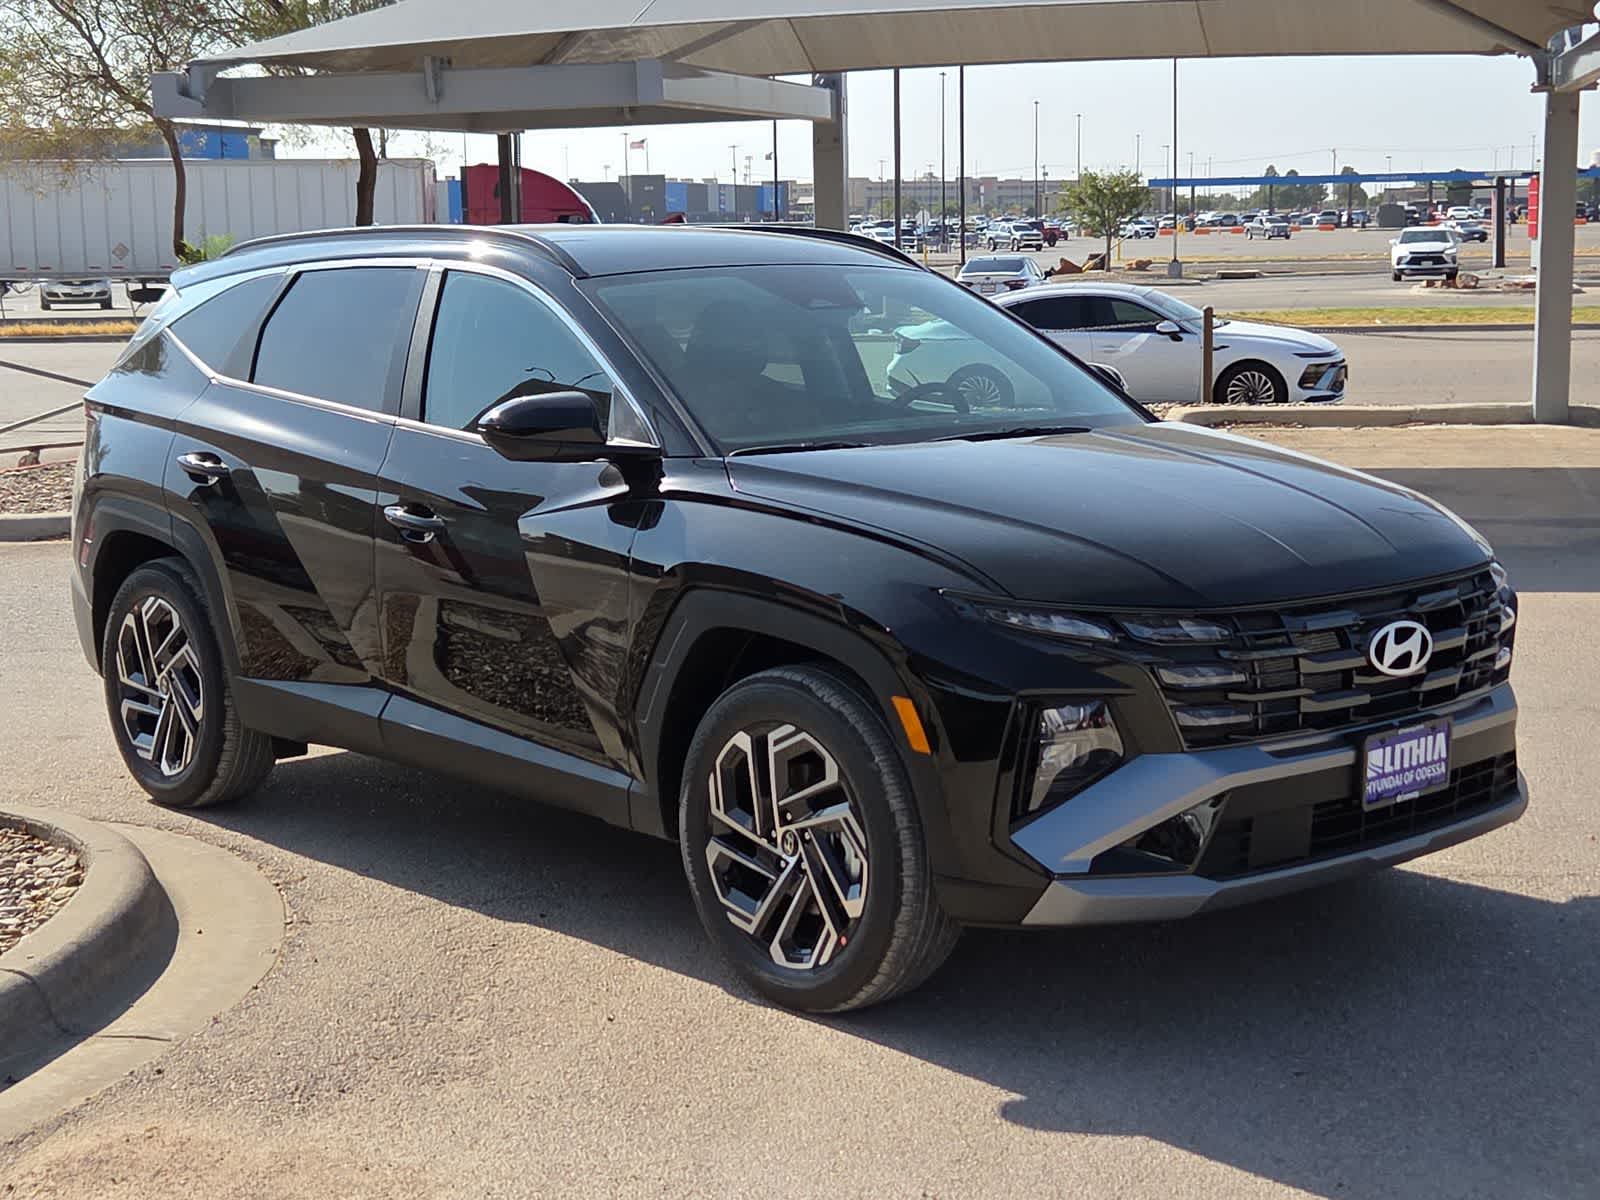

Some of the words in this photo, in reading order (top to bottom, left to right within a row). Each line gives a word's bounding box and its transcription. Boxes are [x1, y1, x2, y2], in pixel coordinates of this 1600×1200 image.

[1384, 732, 1447, 773] LITHIA
[1366, 775, 1403, 795] HYUNDAI
[1403, 771, 1414, 784] OF
[1415, 761, 1446, 781] ODESSA
